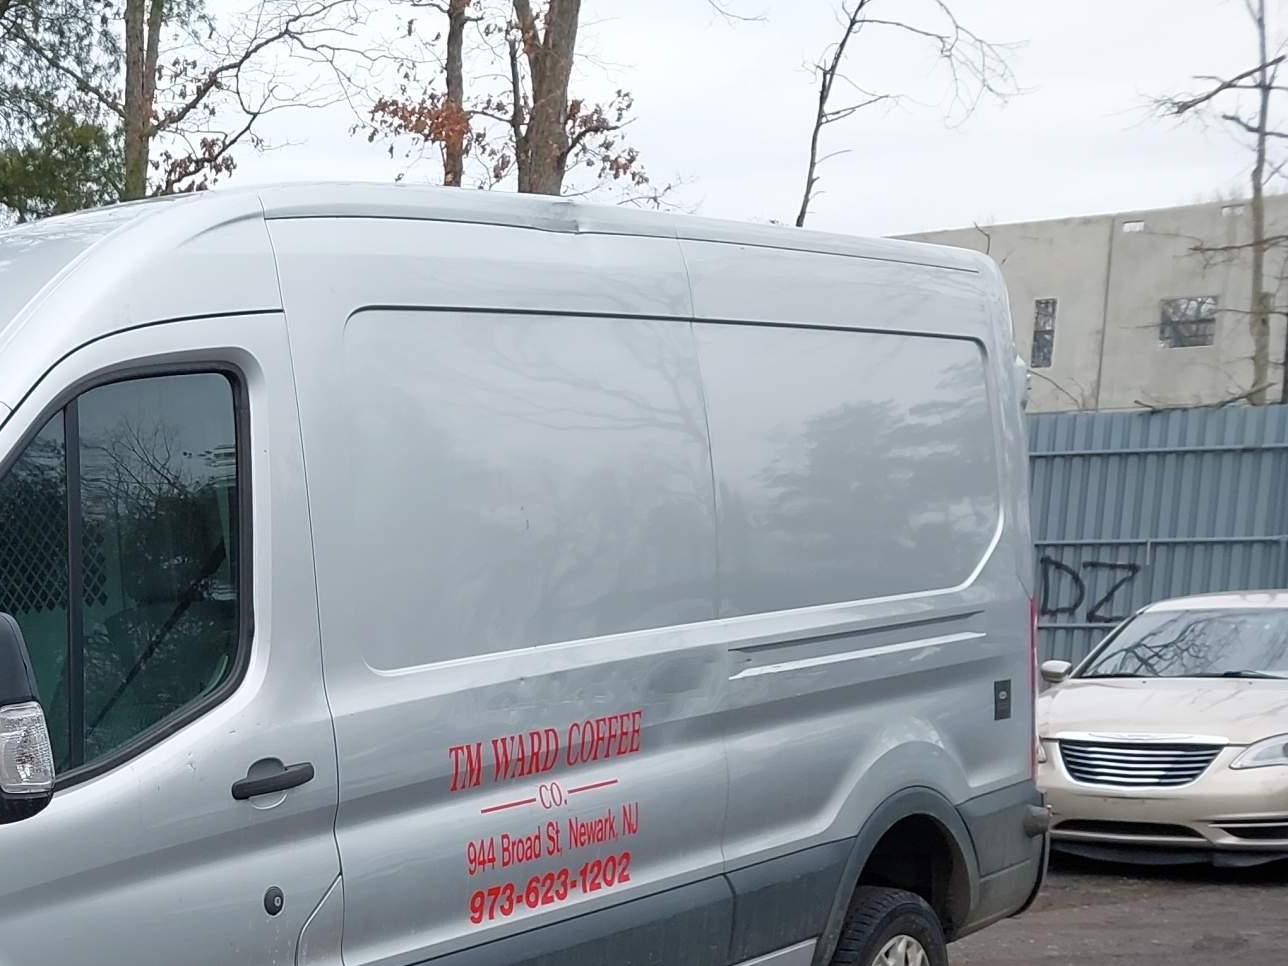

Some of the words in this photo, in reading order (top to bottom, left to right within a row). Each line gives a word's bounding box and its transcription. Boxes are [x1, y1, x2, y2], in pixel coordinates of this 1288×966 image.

[449, 742, 483, 791] TM
[492, 728, 560, 782] WARD
[566, 711, 643, 766] COFFEE
[467, 838, 496, 875] 944
[501, 826, 542, 867] Broad
[623, 802, 639, 836] NJ
[470, 852, 632, 924] 973-623-1202
